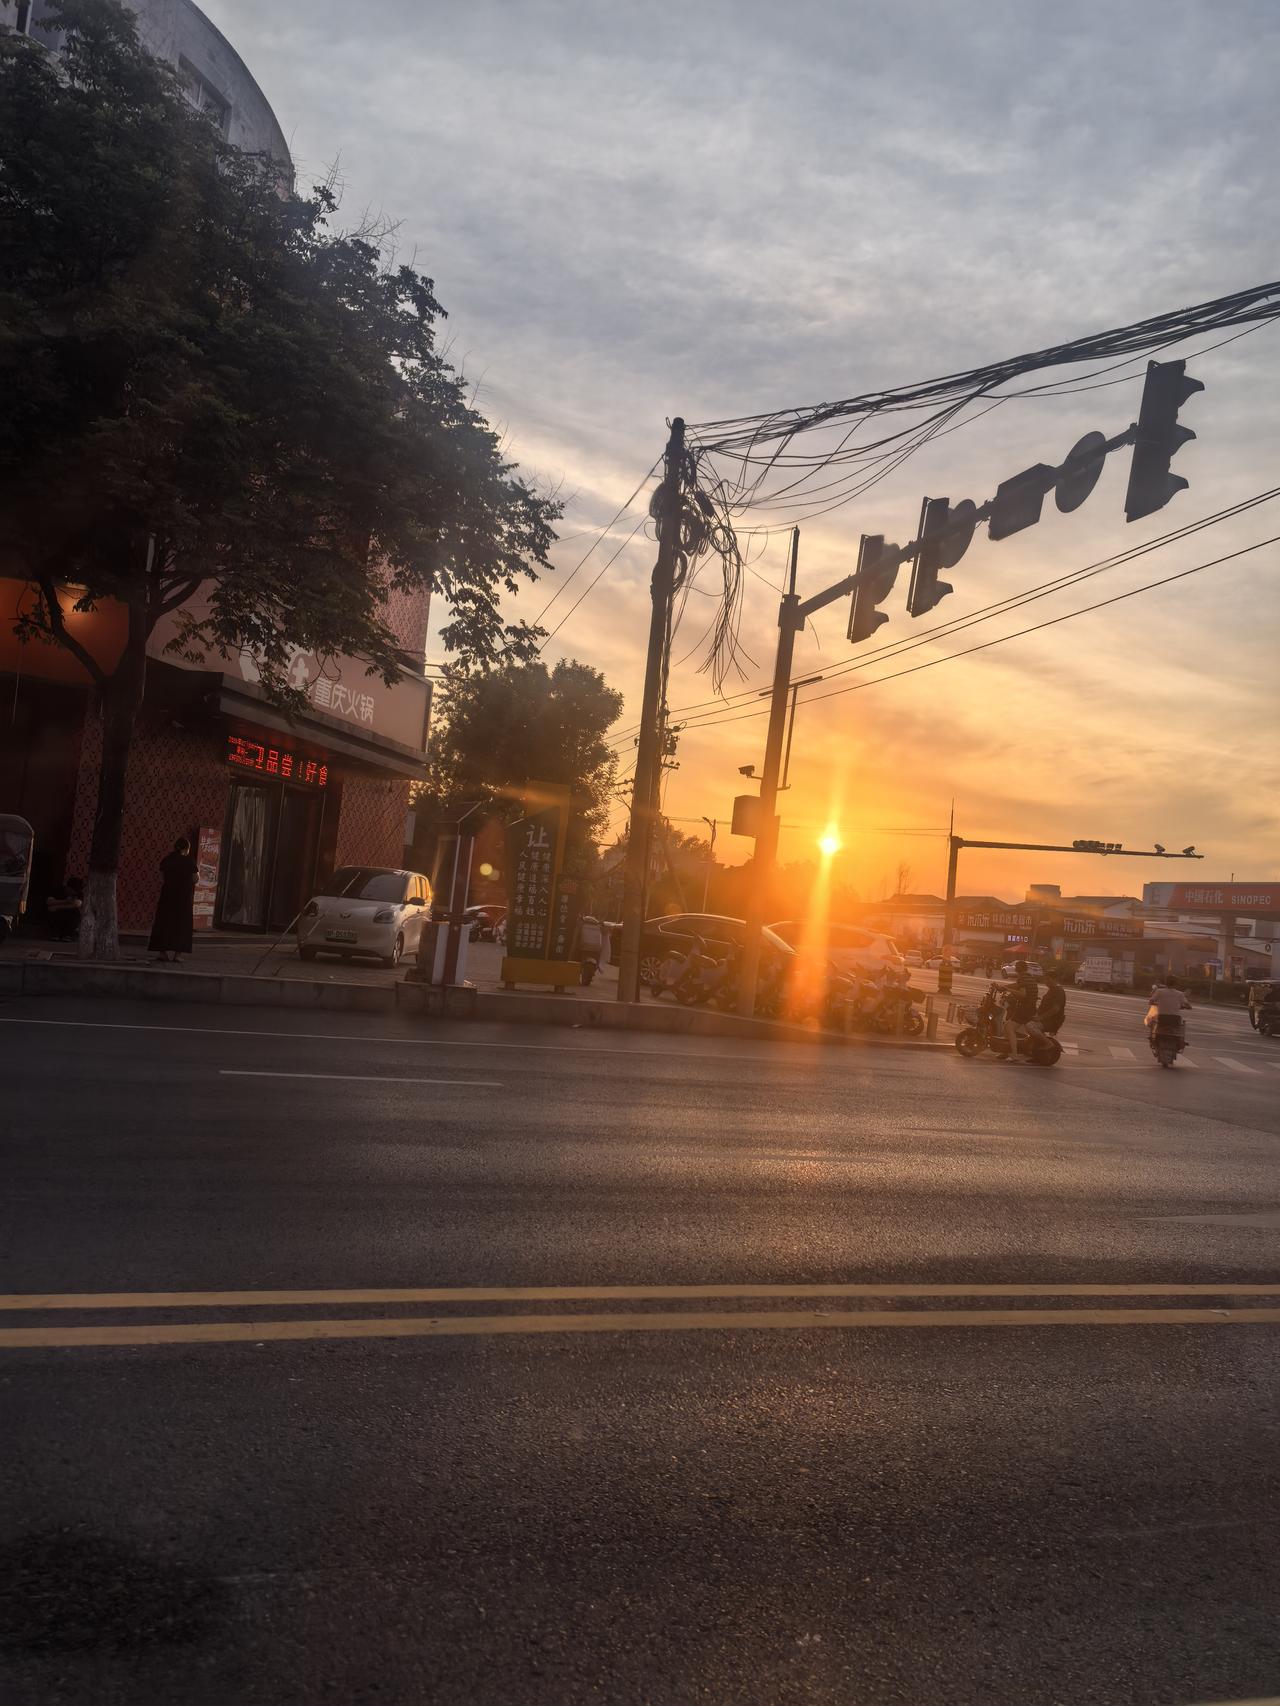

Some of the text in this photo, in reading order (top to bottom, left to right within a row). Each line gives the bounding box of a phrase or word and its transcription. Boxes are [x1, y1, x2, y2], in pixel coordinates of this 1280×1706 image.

[314, 676, 375, 725] 重庆火锅
[526, 823, 550, 849] 让
[1185, 888, 1225, 904] 中国石化
[1231, 895, 1272, 905] SINOPEC
